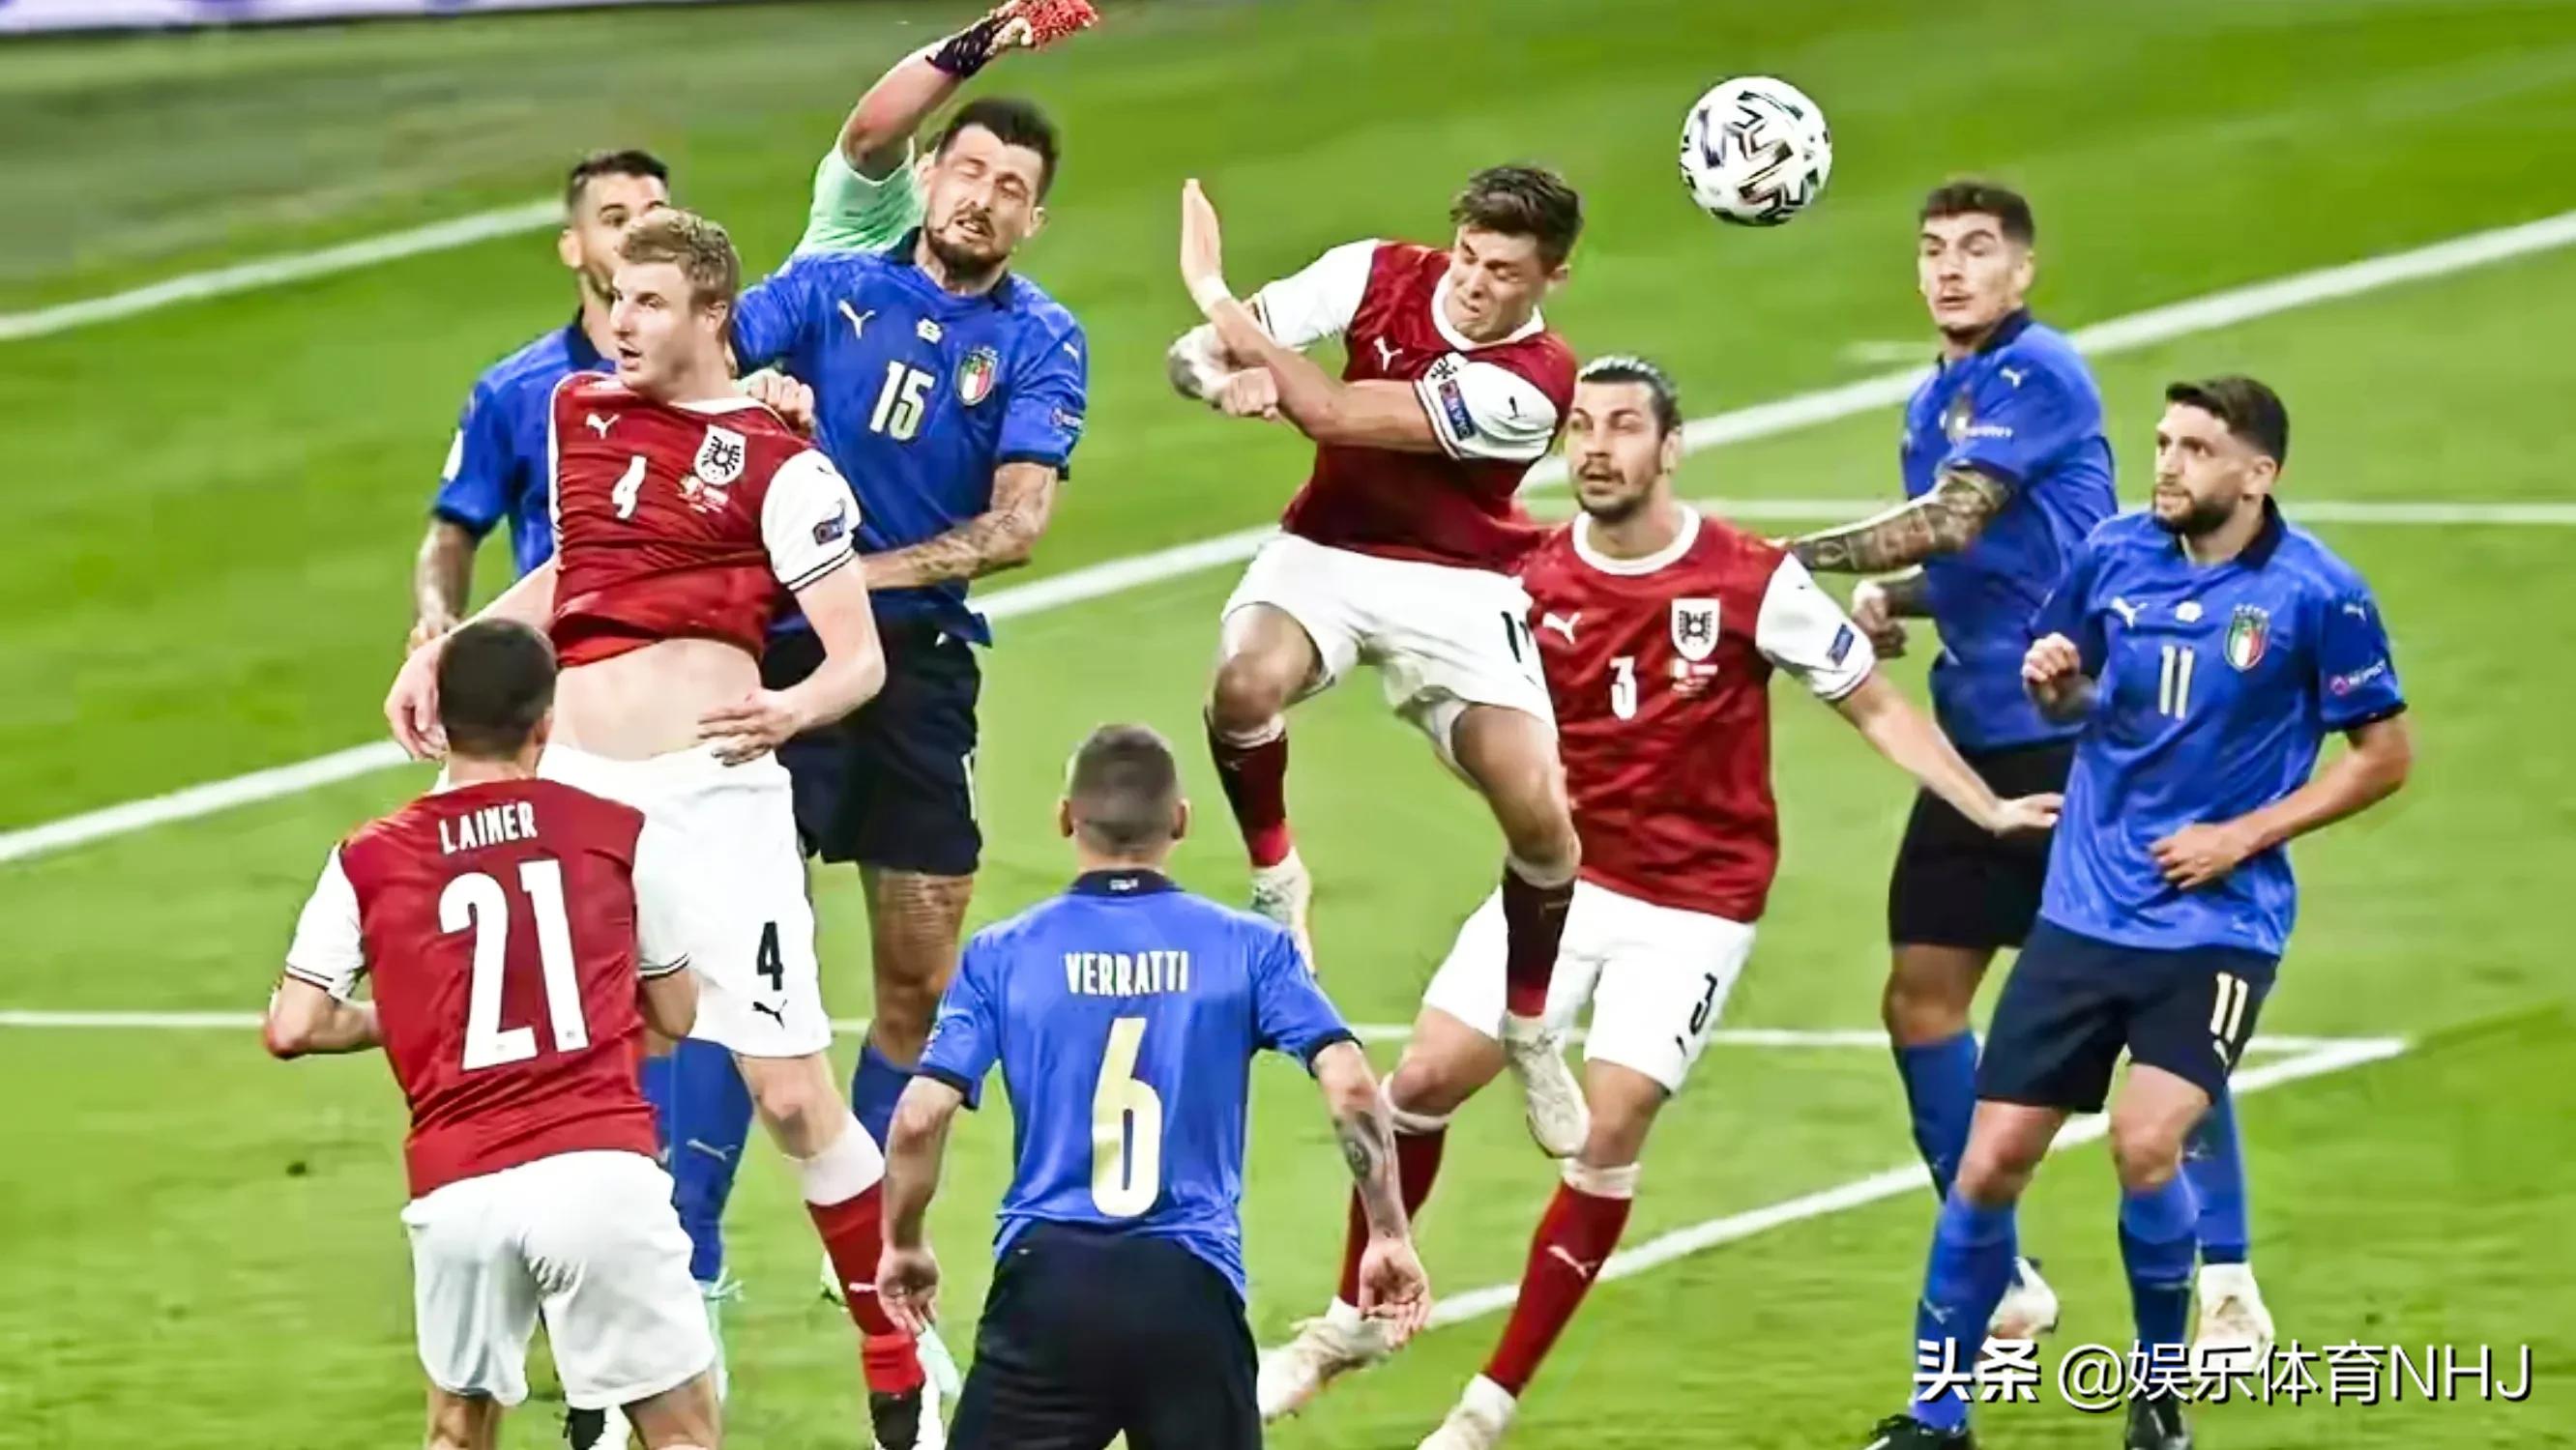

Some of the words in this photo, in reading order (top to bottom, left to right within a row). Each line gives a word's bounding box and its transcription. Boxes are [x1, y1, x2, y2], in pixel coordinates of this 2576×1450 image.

[869, 359, 936, 442] 15
[611, 454, 647, 520] 4
[1608, 654, 1638, 721] 3
[2159, 645, 2194, 719] 11
[438, 800, 538, 856] LAINER
[438, 858, 590, 1070] 21
[756, 920, 784, 992] 4
[1064, 950, 1189, 997] VERRATTI
[1689, 972, 1717, 1035] 3
[2210, 972, 2248, 1044] 11
[1092, 1017, 1161, 1217] 6
